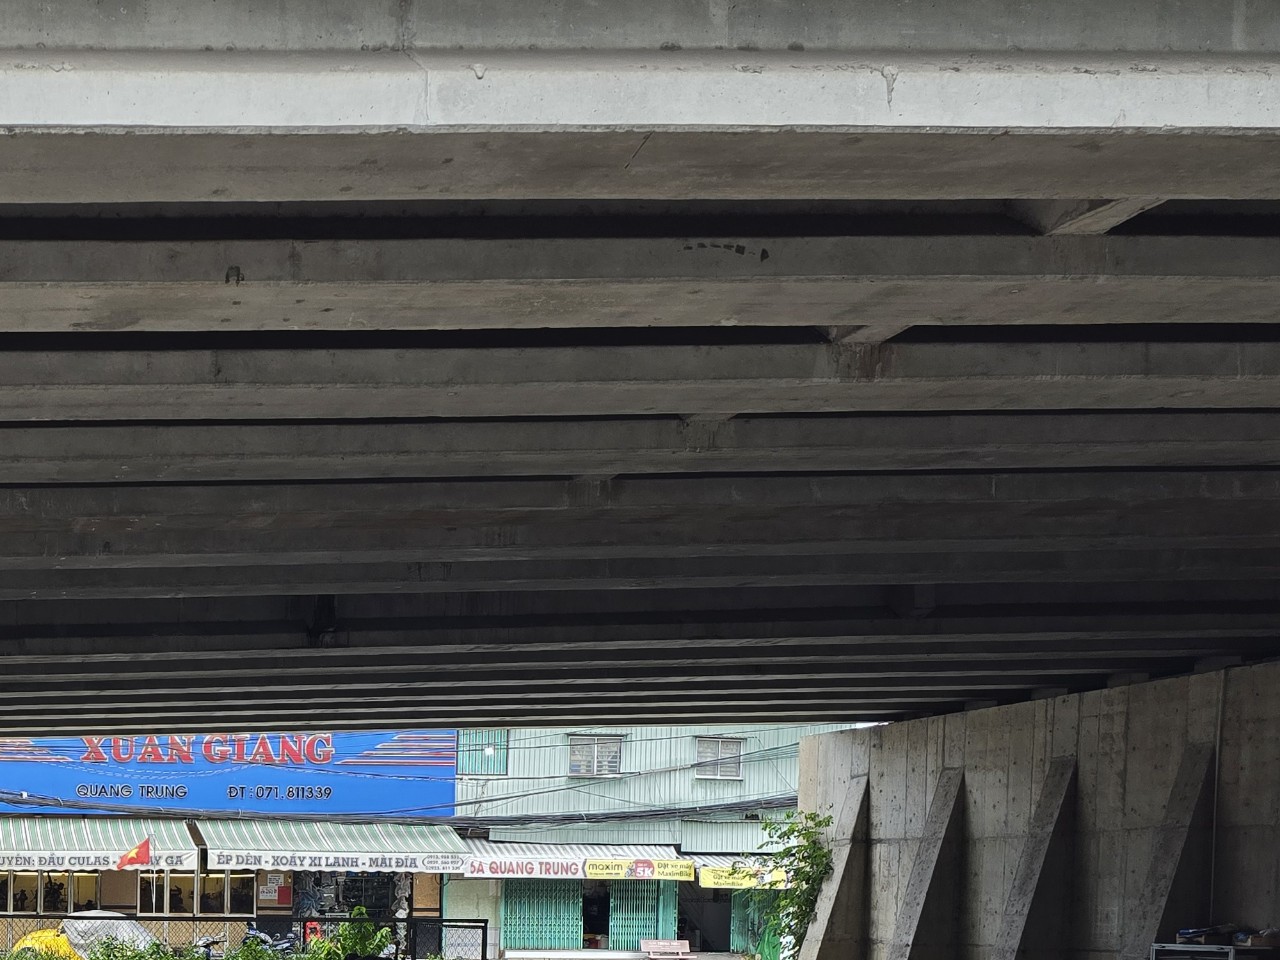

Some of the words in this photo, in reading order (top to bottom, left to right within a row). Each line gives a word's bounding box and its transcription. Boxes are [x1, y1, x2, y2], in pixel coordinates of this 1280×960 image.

[202, 733, 335, 765] GIANG
[76, 784, 133, 798] QUANG
[139, 784, 188, 798] TRUNG
[68, 856, 110, 866] CULAS
[271, 853, 306, 867] XOÁY
[325, 857, 359, 868] LANH
[588, 861, 623, 870] maxim
[488, 860, 535, 875] QUANG
[538, 861, 579, 875] TRUNG
[636, 867, 654, 876] 5K
[657, 870, 692, 878] MaximBike
